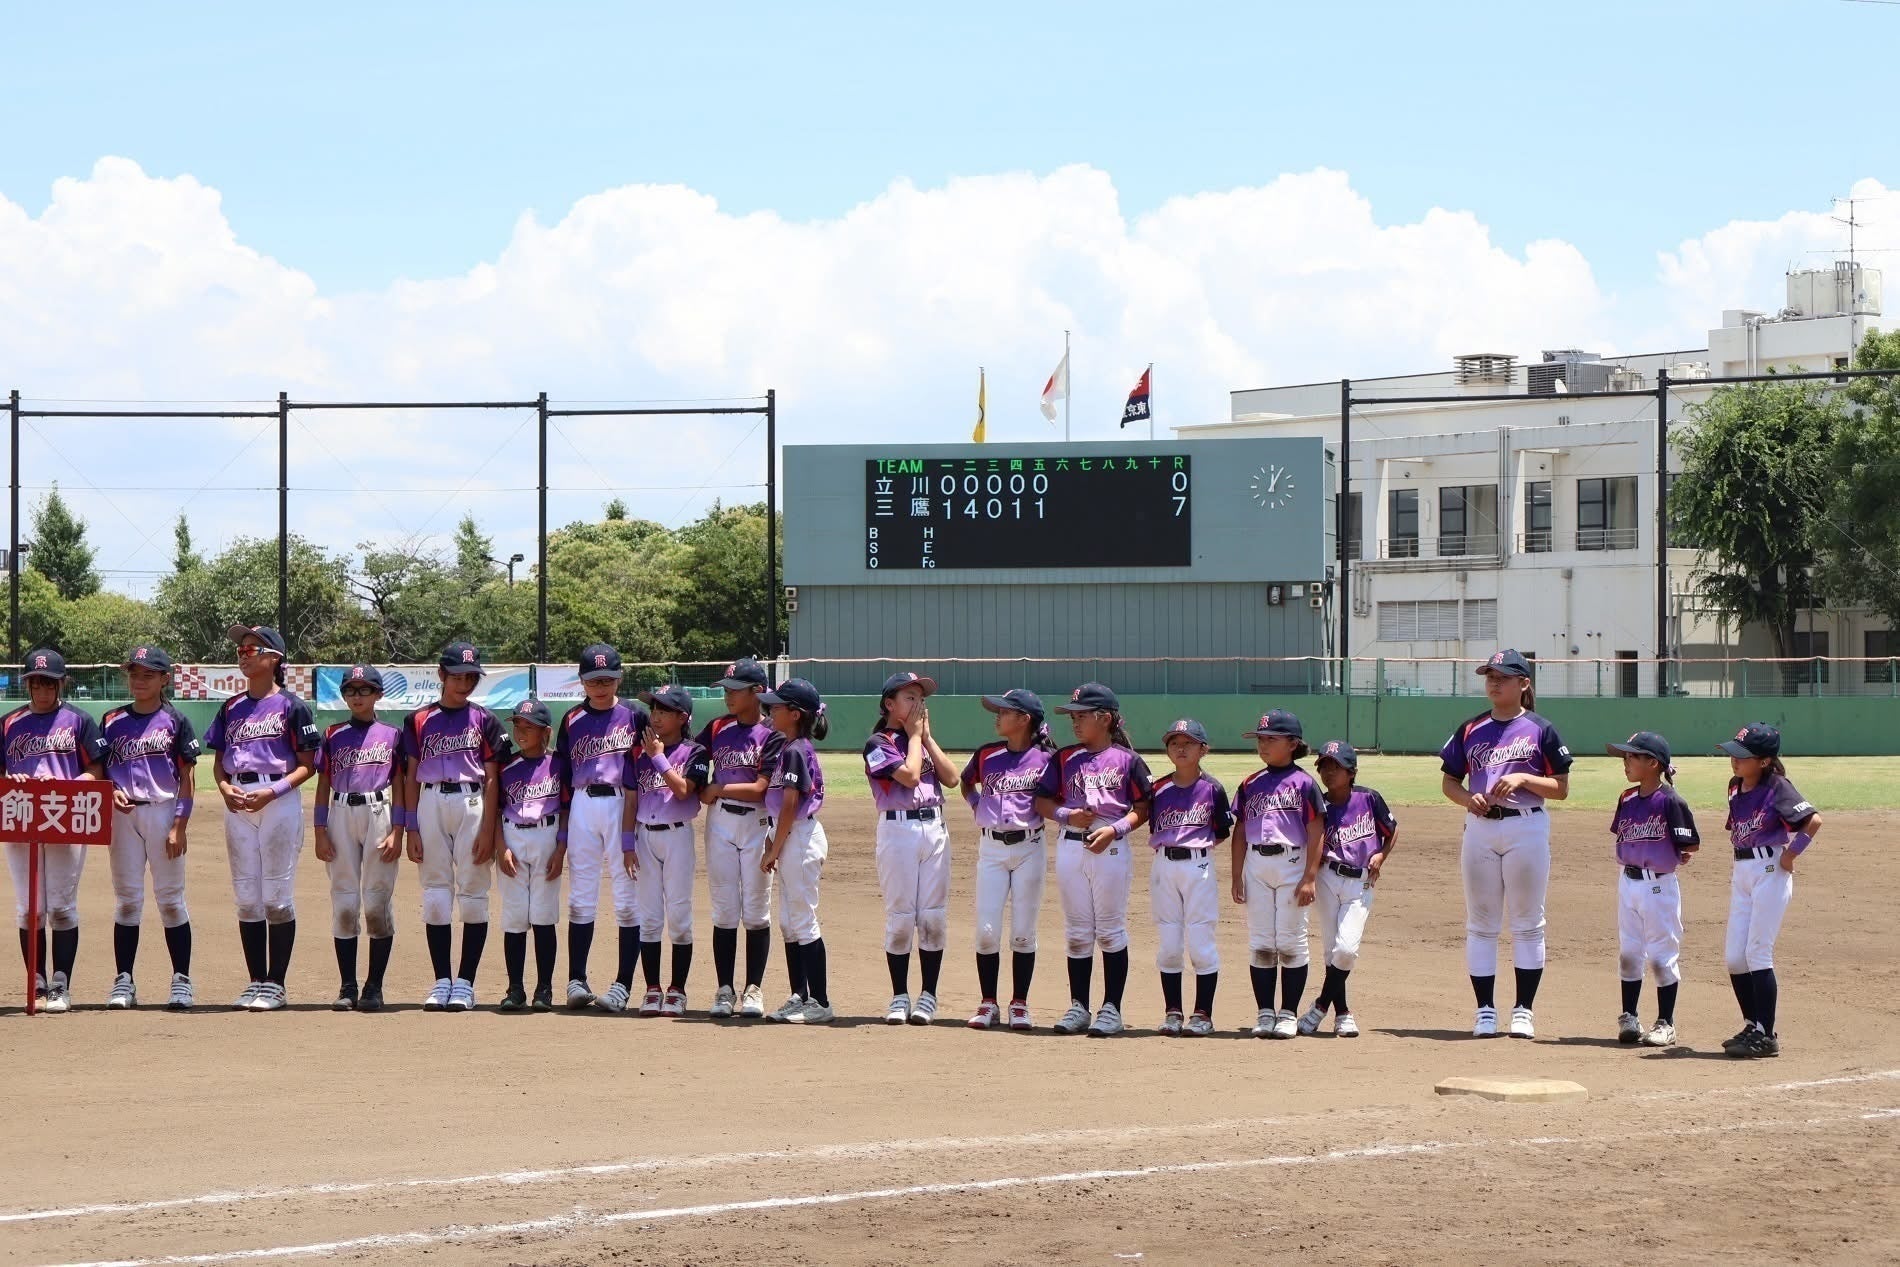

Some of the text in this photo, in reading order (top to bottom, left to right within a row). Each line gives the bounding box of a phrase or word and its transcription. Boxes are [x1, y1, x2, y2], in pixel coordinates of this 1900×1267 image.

[876, 459, 923, 474] TEAM
[963, 460, 977, 471] 二
[987, 459, 999, 472] 三
[1010, 459, 1023, 471] 四
[1033, 458, 1046, 471] 五
[1055, 458, 1069, 471] 六
[1079, 457, 1092, 471] 七
[1102, 459, 1115, 470] 八
[1125, 457, 1139, 470] 九
[1148, 456, 1161, 470] 十
[1174, 456, 1184, 469] R
[875, 476, 930, 495] 立川
[940, 471, 1188, 495] 0 0 0 0 0 0
[875, 497, 930, 517] 三鷹
[942, 496, 1187, 519] 1 4 0 1 1 7
[869, 527, 879, 539] B
[923, 527, 934, 539] H
[869, 541, 879, 554] S
[923, 541, 933, 554] E
[213, 675, 251, 694] nip
[414, 680, 443, 690] ellea
[400, 694, 438, 707] エリエ
[0, 788, 102, 835] 飾支部
